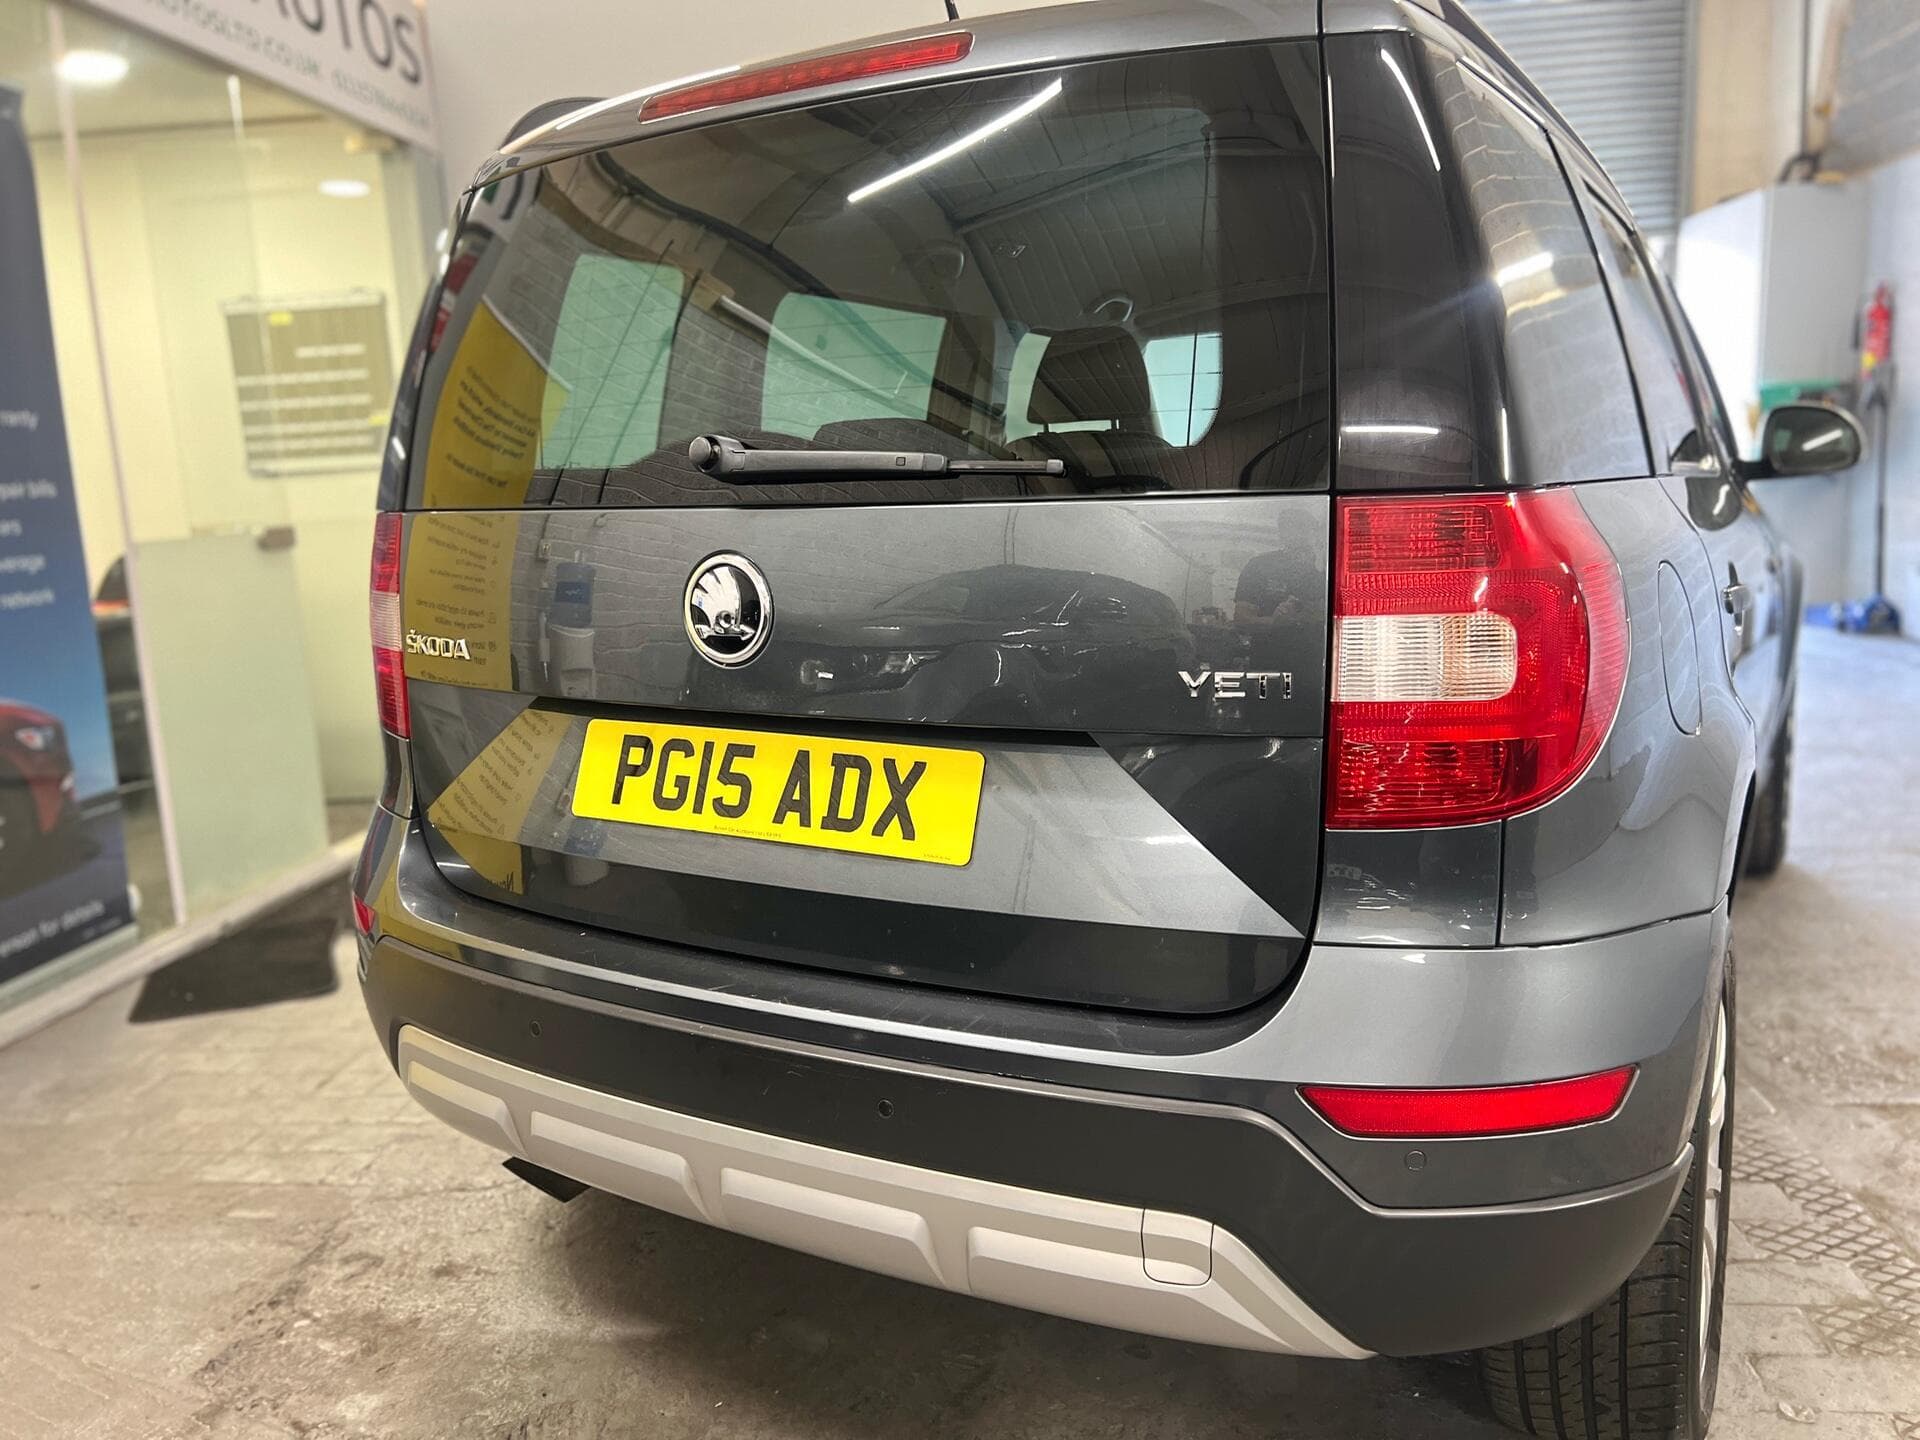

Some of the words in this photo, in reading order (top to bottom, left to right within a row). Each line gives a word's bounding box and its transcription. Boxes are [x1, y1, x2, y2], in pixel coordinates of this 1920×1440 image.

[249, 0, 423, 87] UTOS
[26, 479, 57, 499] bills
[406, 629, 471, 661] ŠKODA
[1178, 671, 1292, 699] YETI
[611, 734, 756, 819] PG15
[772, 750, 927, 841] ADX
[39, 918, 59, 938] for
[61, 900, 104, 931] details
